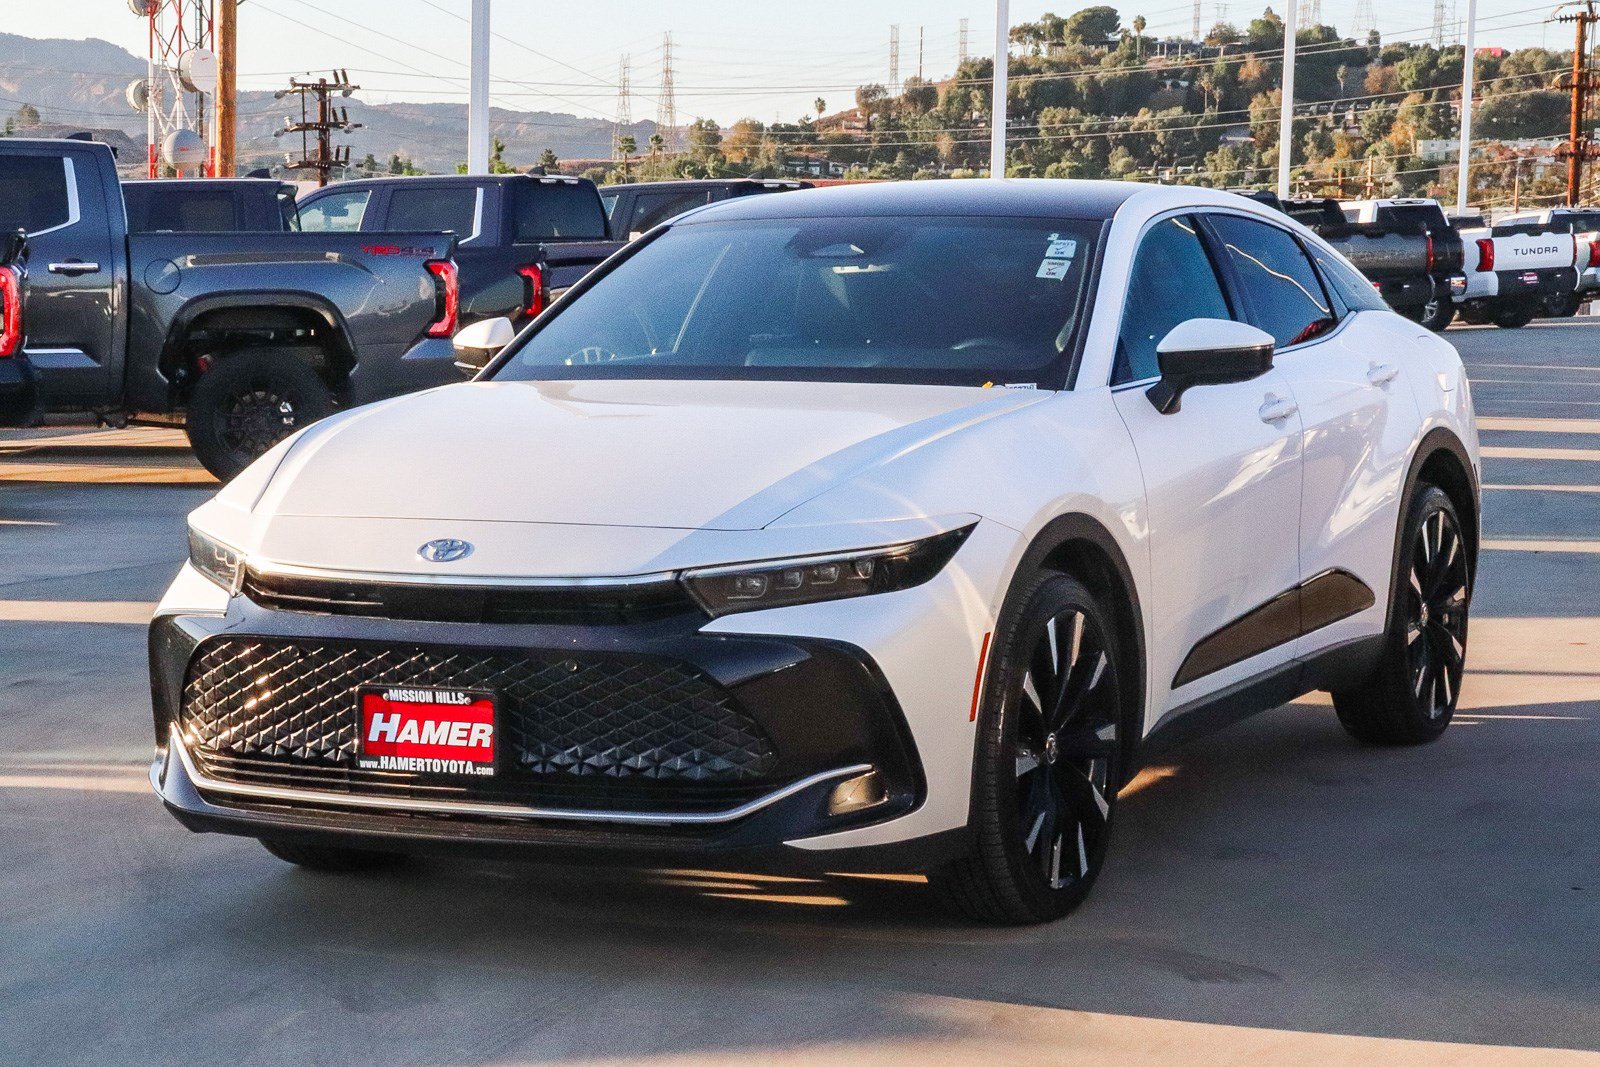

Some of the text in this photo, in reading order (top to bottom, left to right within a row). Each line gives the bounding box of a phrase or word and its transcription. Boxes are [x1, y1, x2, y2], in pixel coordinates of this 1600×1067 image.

[1513, 246, 1559, 256] TUNDRA
[389, 688, 465, 705] MISSION HILLS
[367, 712, 494, 748] HAMER
[359, 755, 494, 776] www.HAMERTOYOTA.com
